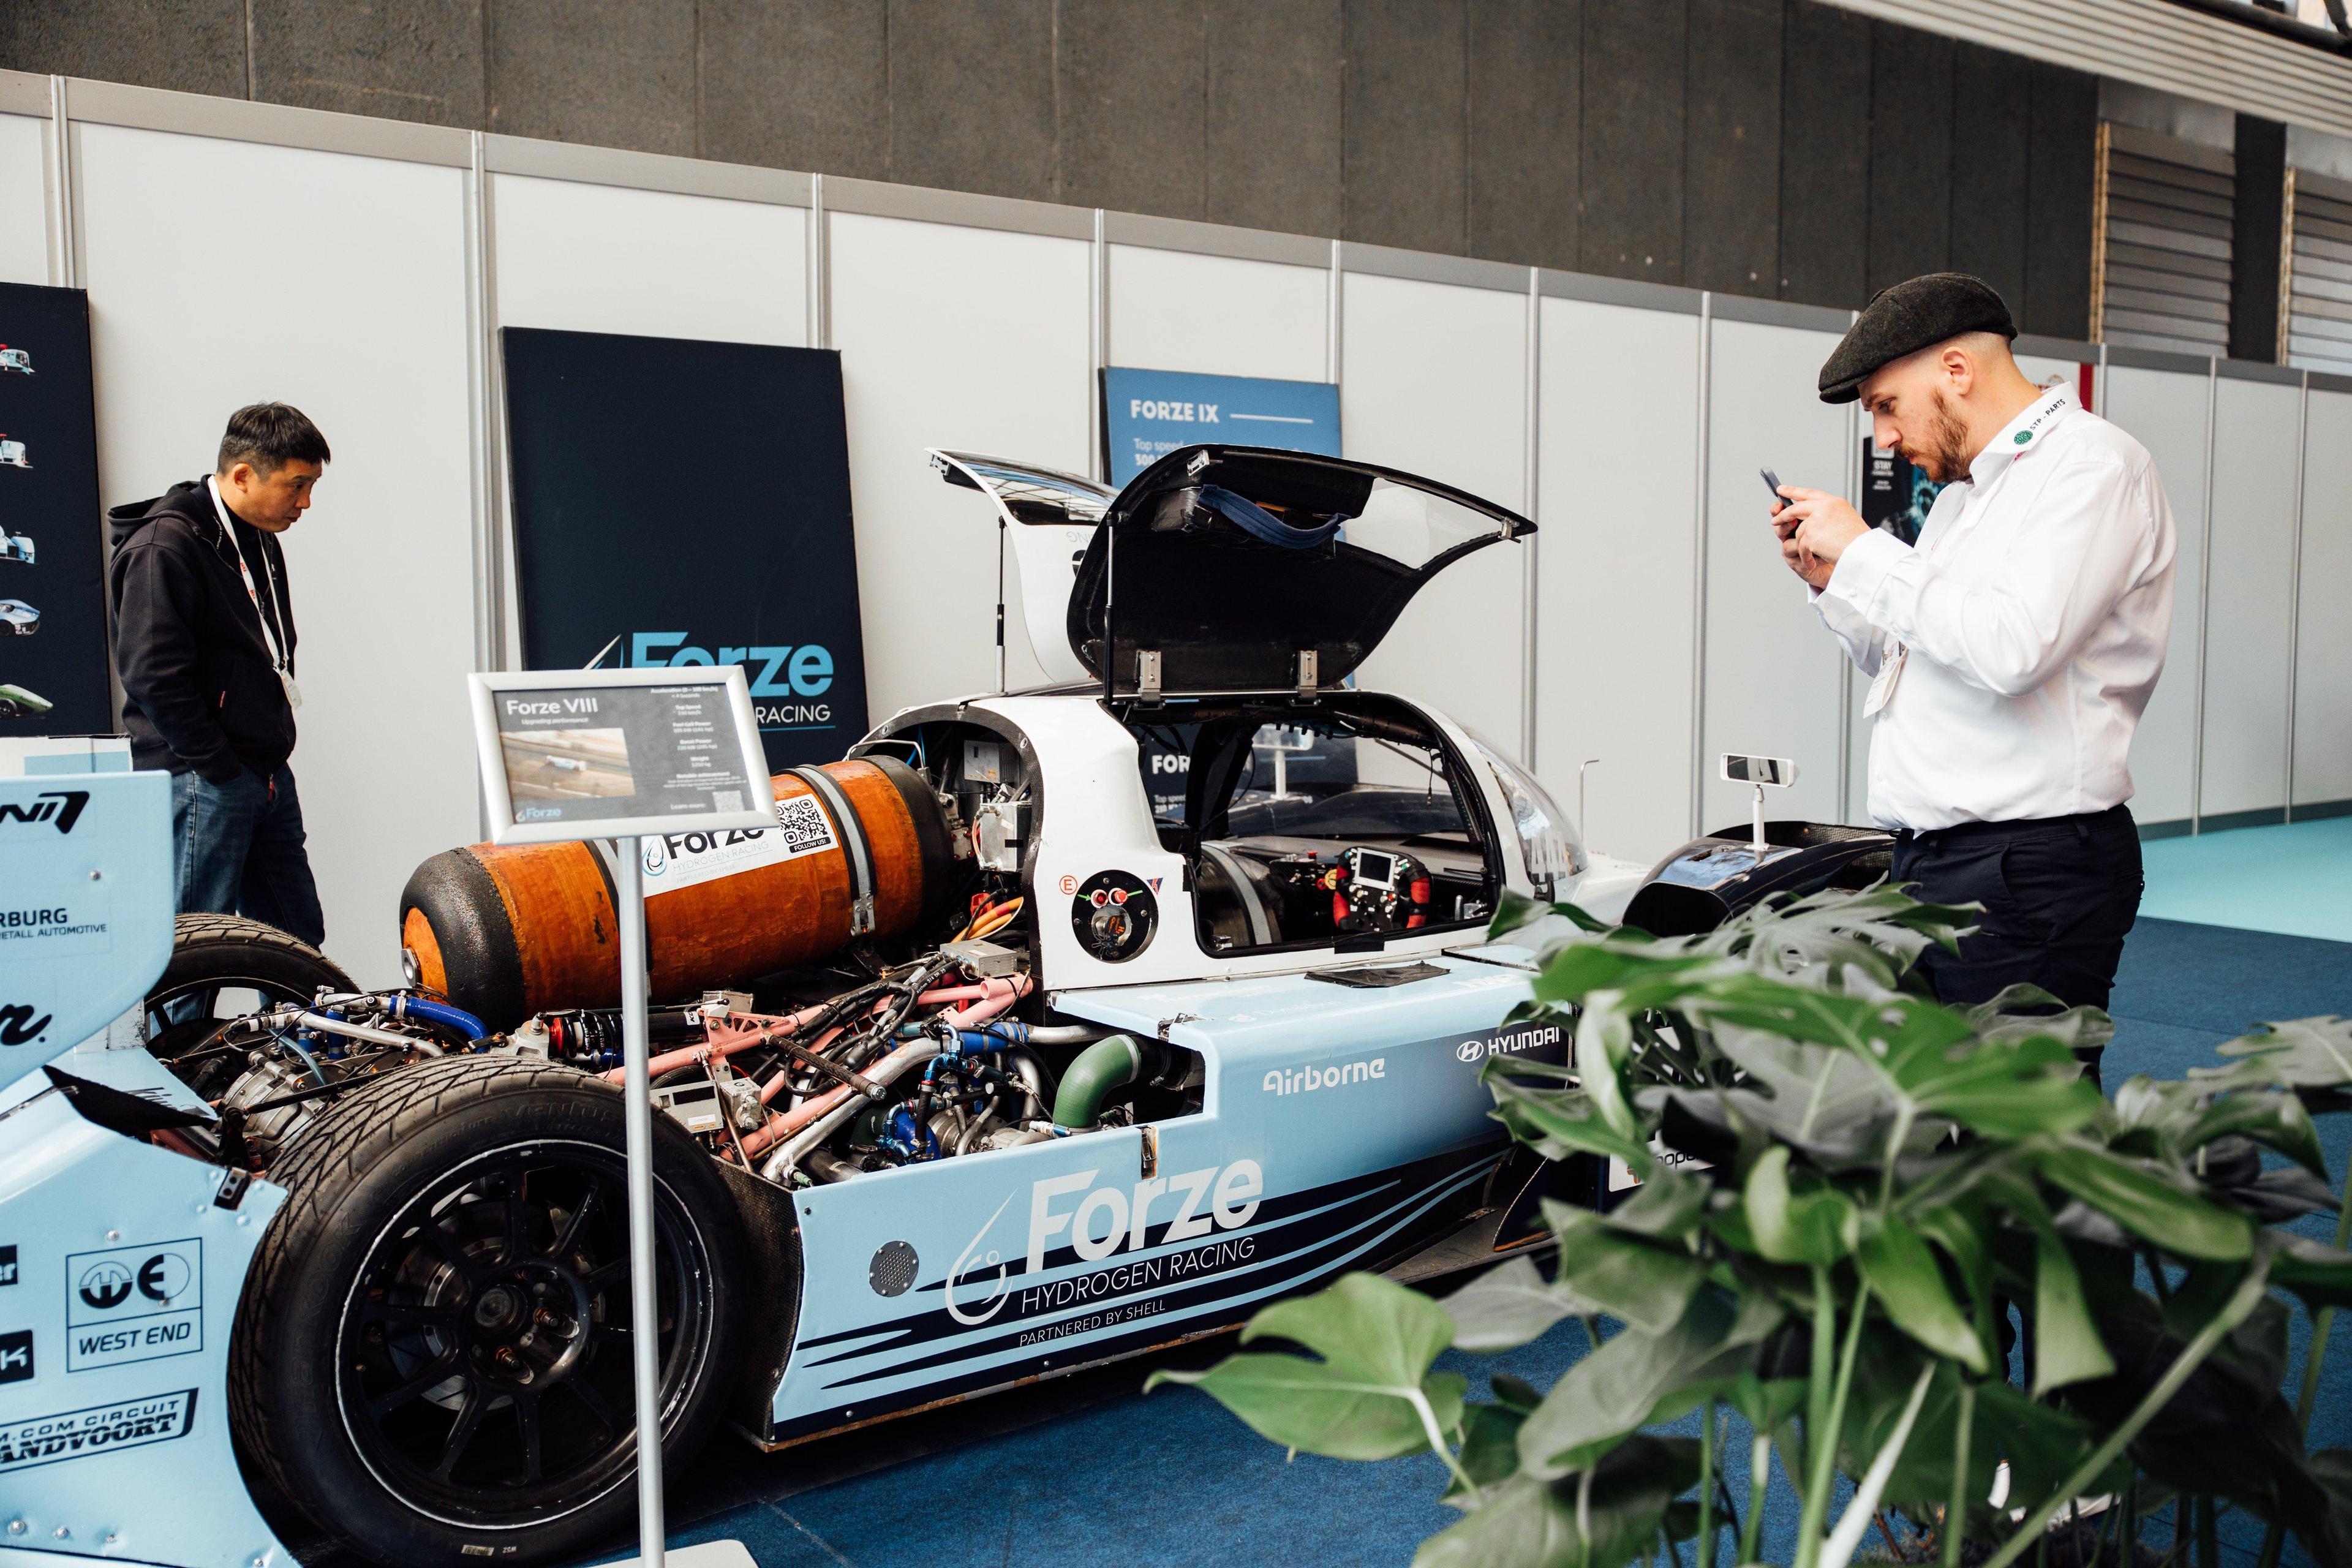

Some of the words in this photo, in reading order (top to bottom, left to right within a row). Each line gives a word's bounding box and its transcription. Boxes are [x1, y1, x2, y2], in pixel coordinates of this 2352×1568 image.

[1130, 399, 1194, 421] FORZE
[1199, 403, 1219, 423] IX
[2030, 418, 2041, 430] STP
[2045, 399, 2065, 415] PARTS
[1133, 437, 1152, 452] Top
[1873, 459, 1893, 470] STAY
[507, 699, 561, 715] Forze
[563, 697, 598, 713] VIII
[755, 704, 831, 725] RACING
[1152, 754, 1191, 774] FOR
[526, 808, 562, 818] Forze
[673, 851, 730, 873] HYDROGEN
[732, 841, 769, 857] RACING
[794, 840, 813, 851] FOLLOW
[815, 839, 827, 847] US!
[0, 930, 34, 940] ETALL
[37, 924, 107, 938] AUTOMOTIVE
[1488, 1027, 1559, 1055] HYUNDAI
[1026, 1159, 1263, 1276] Forze
[1022, 1262, 1161, 1313] HYDROGEN
[1170, 1238, 1255, 1278] RACING
[1020, 1317, 1101, 1347] PARTNERED
[1105, 1313, 1122, 1330] BY
[1126, 1303, 1166, 1321] SHELL
[79, 1330, 140, 1355] WEST
[146, 1322, 190, 1344] END
[85, 1400, 179, 1427] CIRCUIT
